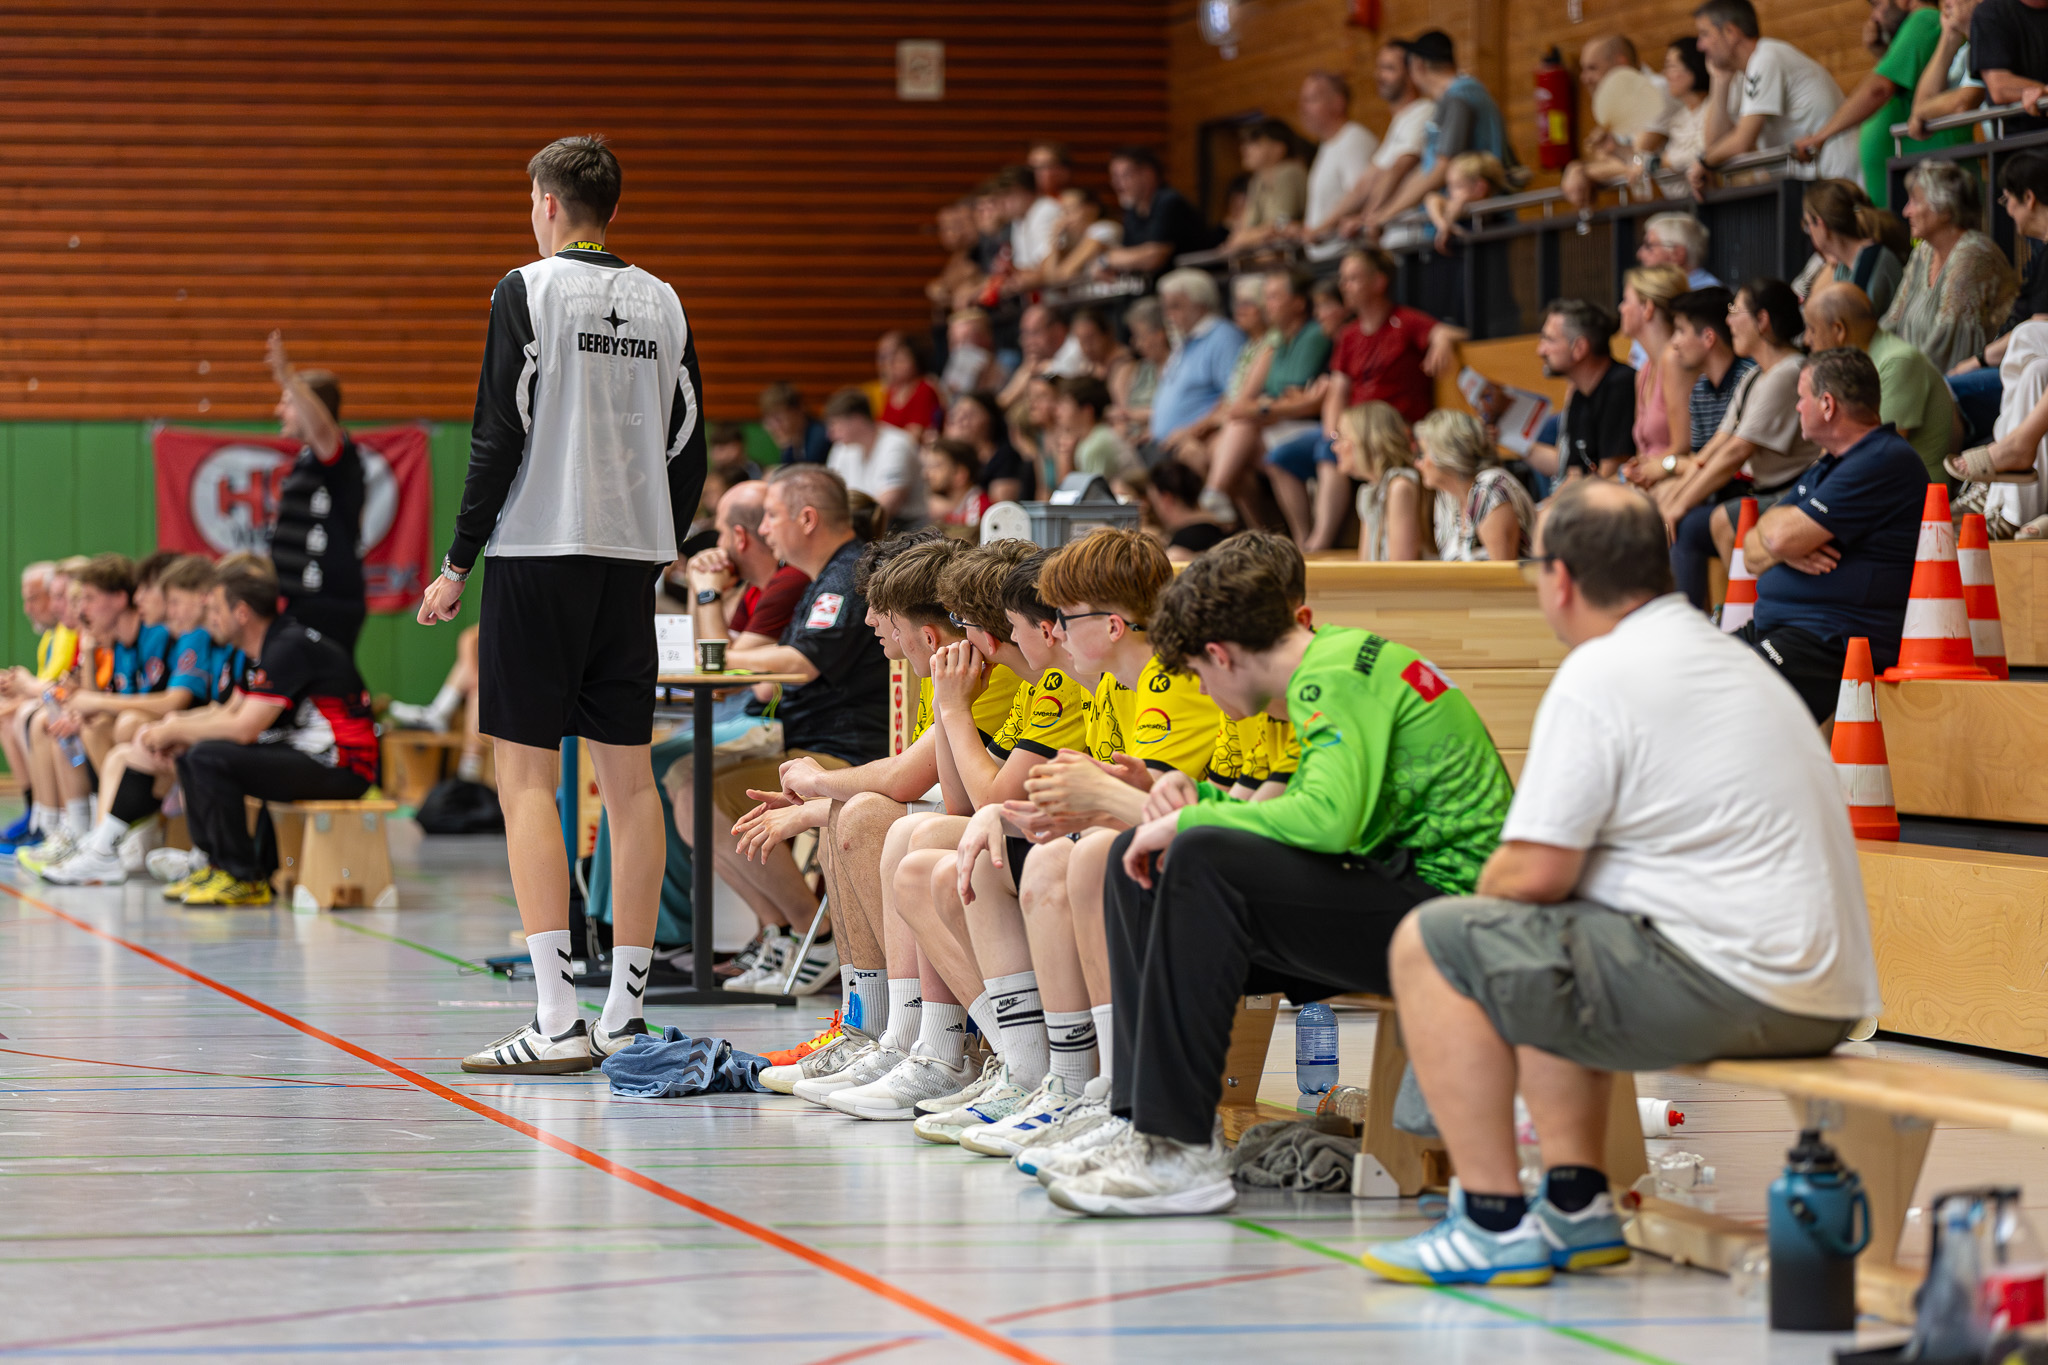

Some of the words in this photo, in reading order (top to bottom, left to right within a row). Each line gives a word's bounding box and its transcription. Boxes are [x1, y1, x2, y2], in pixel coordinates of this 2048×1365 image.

[577, 332, 658, 361] DERBYSTAR
[998, 997, 1018, 1008] NIKE
[1071, 1022, 1093, 1036] NIKE
